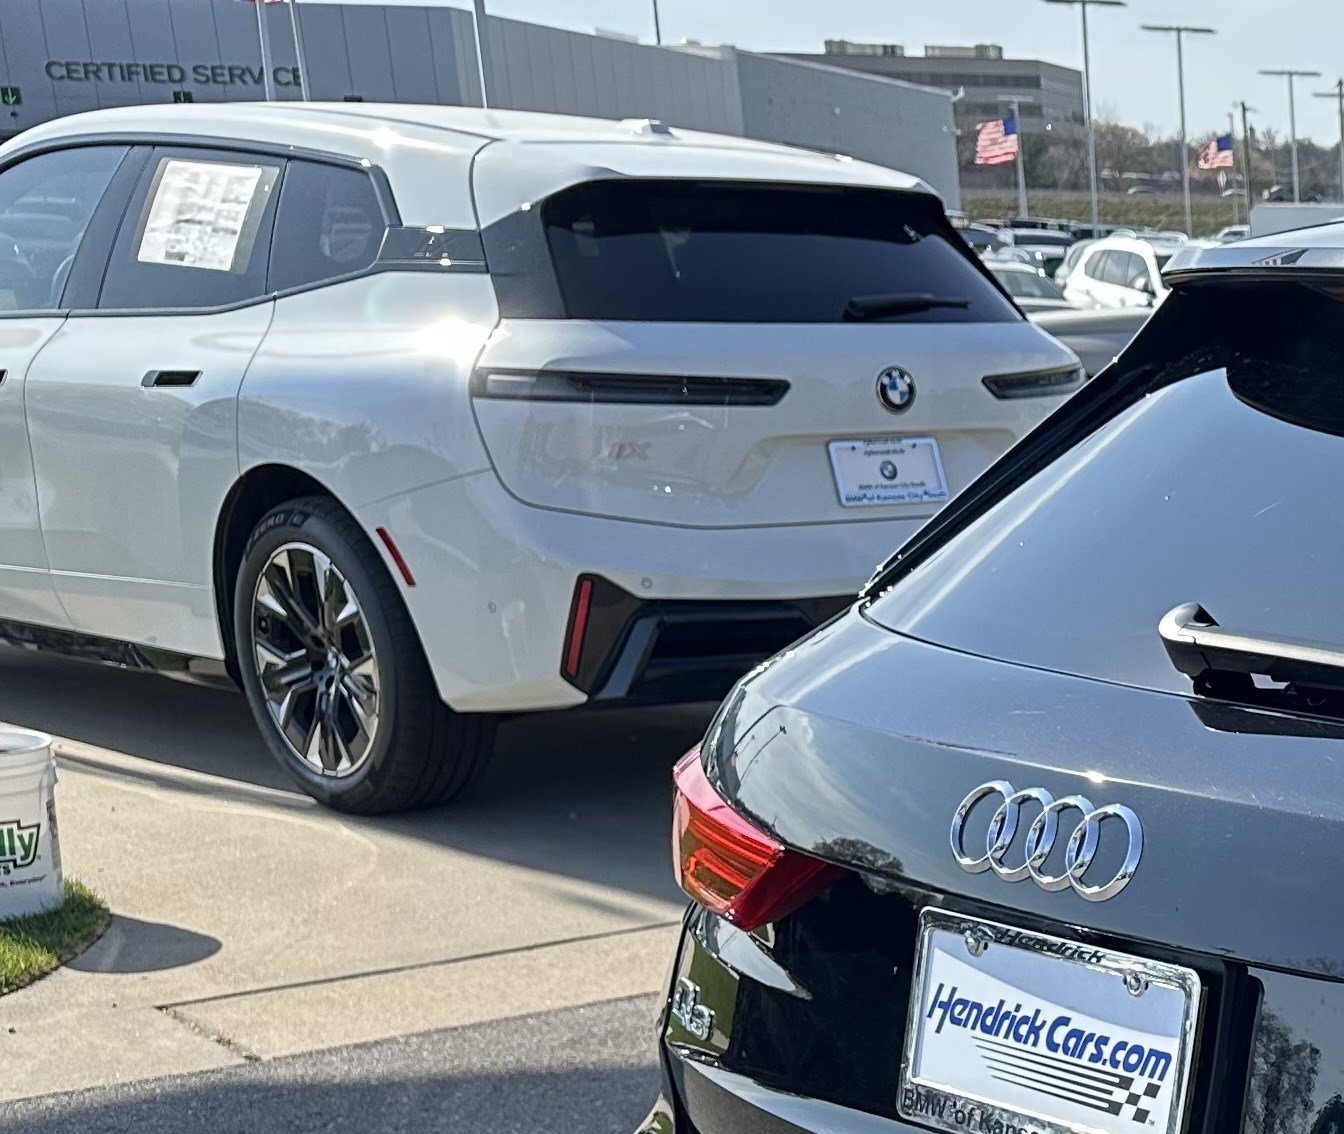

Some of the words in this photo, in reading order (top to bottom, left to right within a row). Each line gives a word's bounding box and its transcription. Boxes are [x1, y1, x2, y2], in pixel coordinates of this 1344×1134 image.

[45, 60, 185, 85] CERTIFIED
[192, 64, 302, 88] SERVCE
[902, 1087, 947, 1120] BMW
[954, 1106, 974, 1126] of
